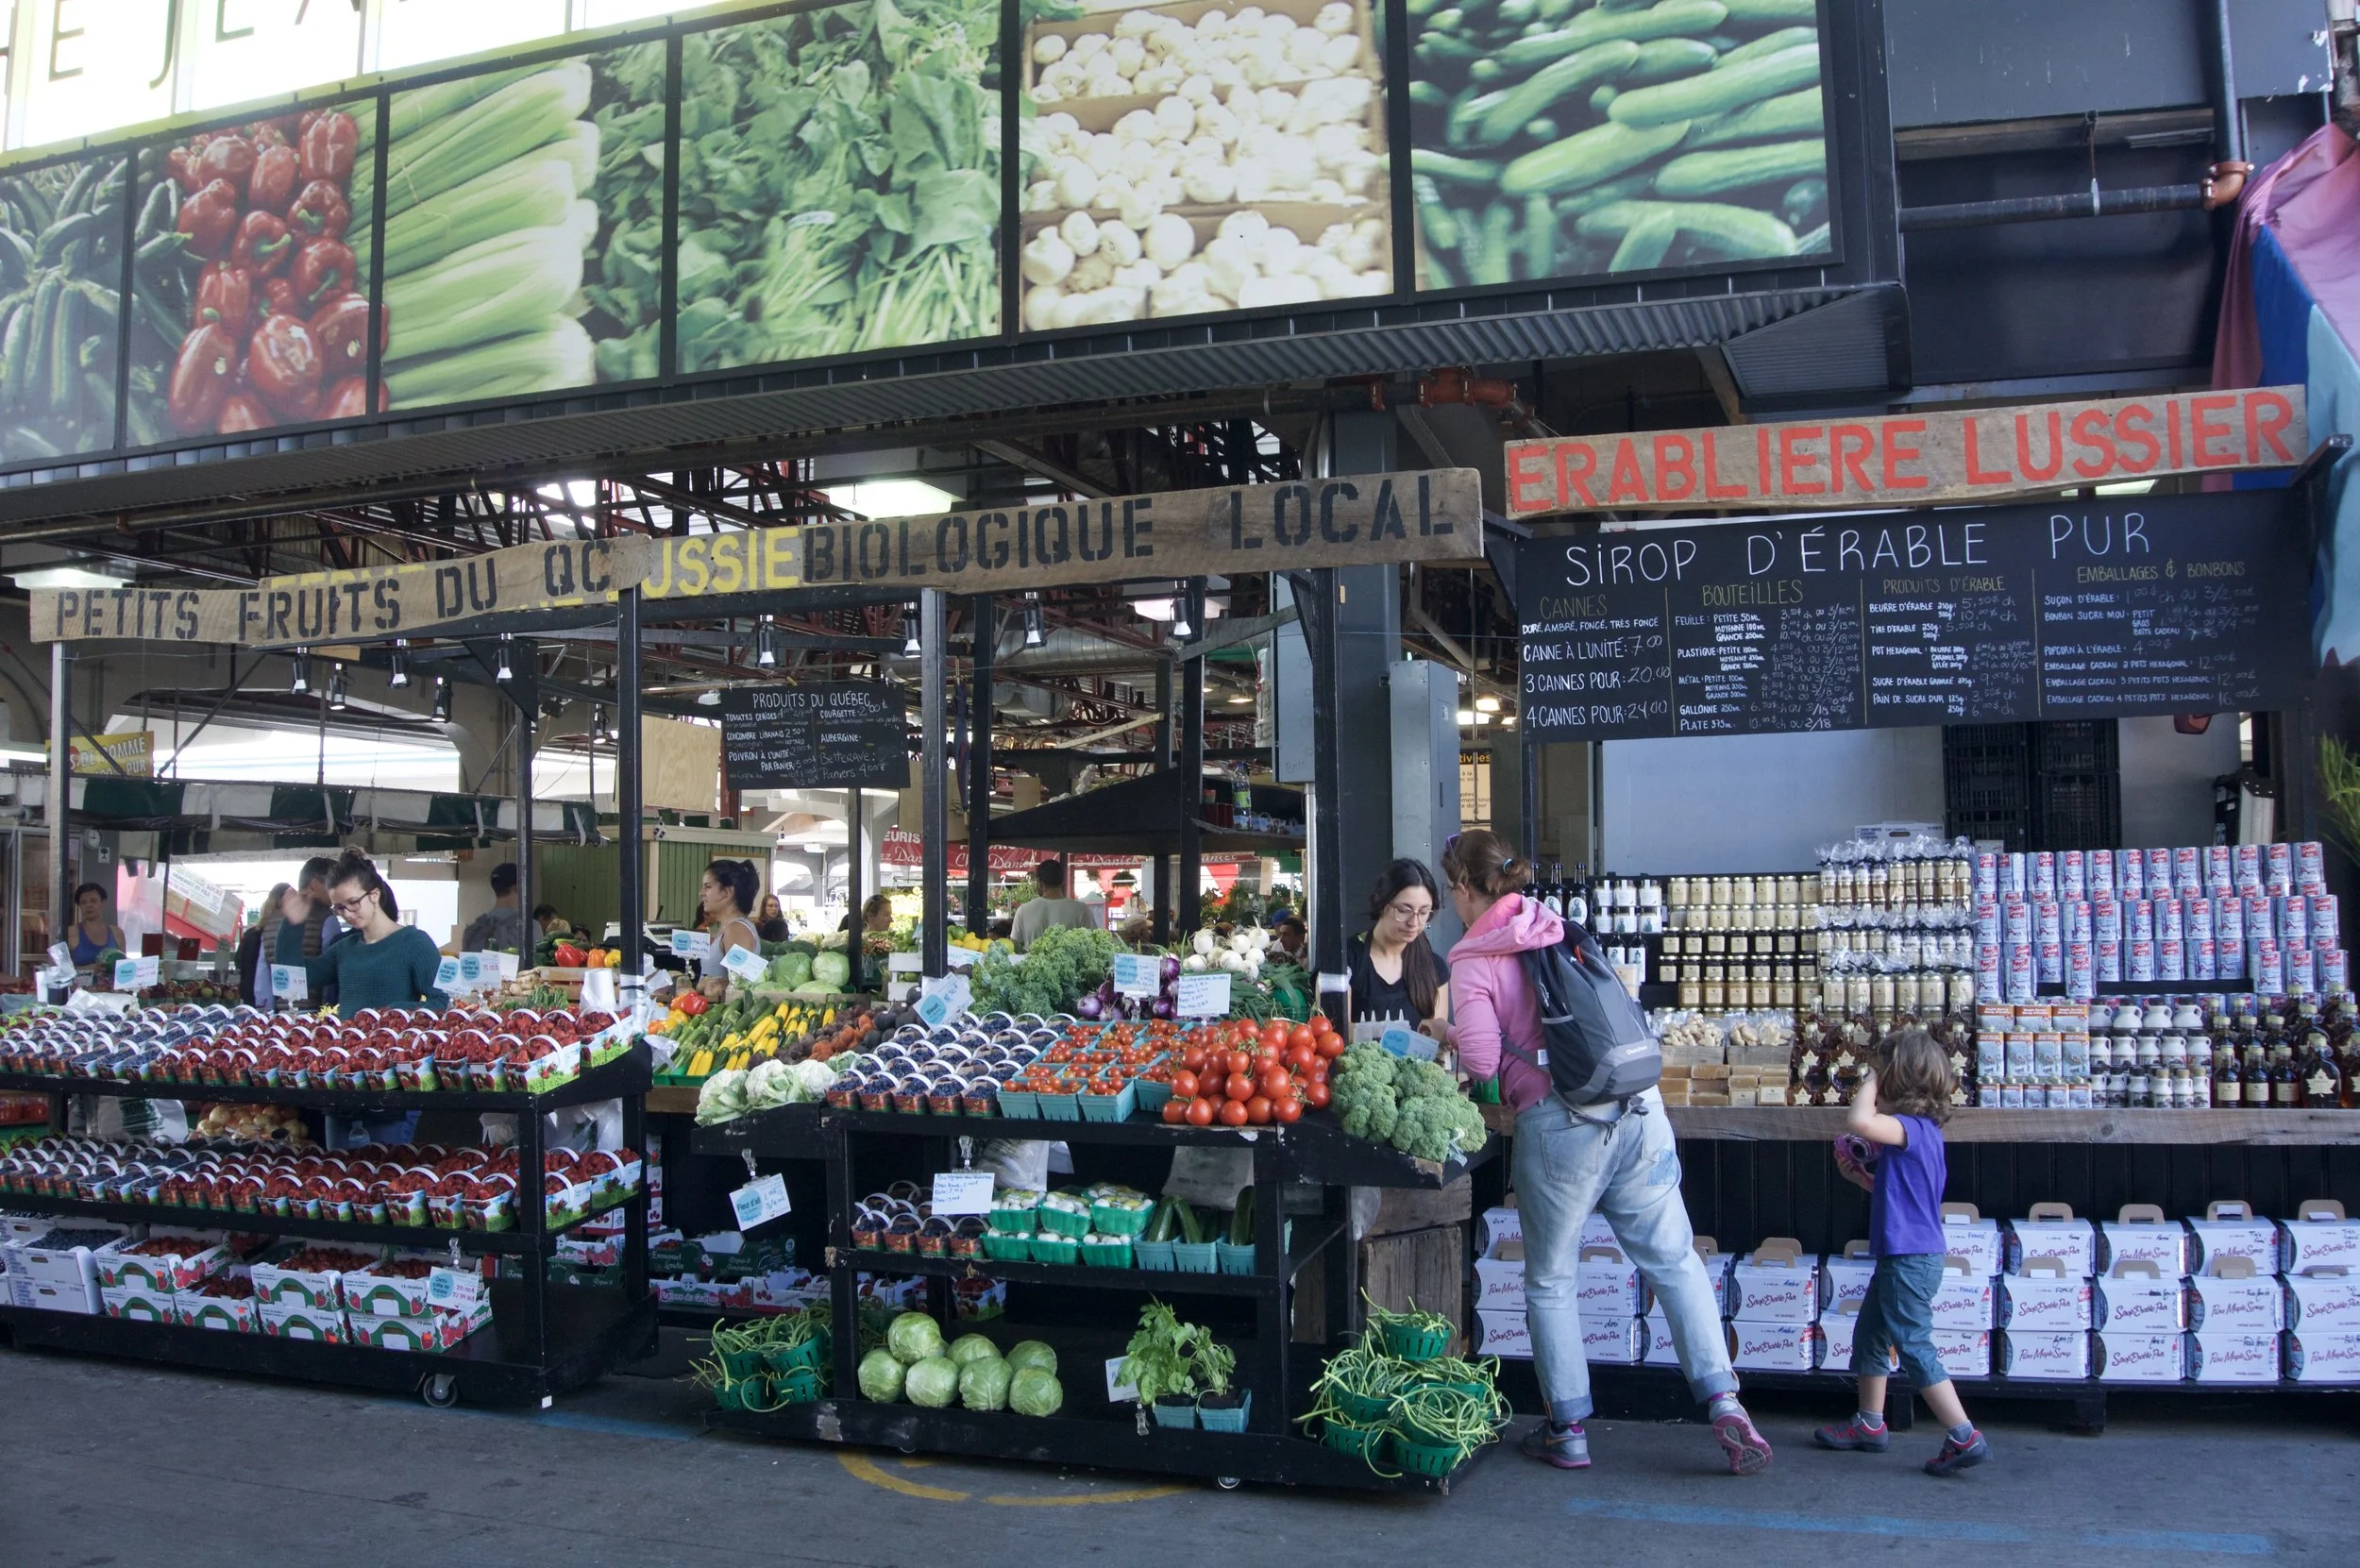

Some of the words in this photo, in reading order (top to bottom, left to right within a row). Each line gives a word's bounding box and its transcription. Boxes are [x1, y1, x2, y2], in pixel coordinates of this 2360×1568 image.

[1509, 419, 1928, 512] ERABLIERE
[1964, 393, 2295, 485] LUSSIER
[803, 497, 1154, 582] BIOLOGIQUE
[1231, 475, 1454, 550] LOCAL
[1747, 521, 1987, 578] D'ÉRABLE
[2050, 512, 2150, 560] PUR
[641, 526, 800, 599] USSIE
[2078, 565, 2158, 583] EMBALLAGES
[2187, 562, 2245, 578] BONBONS
[57, 590, 199, 640] PETITS
[239, 579, 401, 641] FRUITS
[435, 557, 497, 618] DU
[544, 541, 610, 597] QC
[1883, 579, 1940, 594] PRODUITS
[1702, 580, 1804, 606] BOUTEILLES
[1540, 594, 1608, 619] CANNES
[2045, 596, 2072, 607] SUÇON
[1869, 603, 1897, 613] BEURRE
[1713, 613, 1739, 624] PETITE
[2045, 612, 2073, 621] BONBON
[2077, 610, 2104, 620] SUCRE
[2132, 609, 2156, 618] PETIT
[1610, 618, 1630, 630] TRÈS
[1633, 616, 1659, 627] FONCÉ
[1715, 624, 1745, 632] MOYENNE
[2132, 618, 2150, 629] GROS
[1716, 632, 1744, 642] GRANDE
[2154, 627, 2180, 635] CADEAU
[1523, 644, 1562, 662] CANNE
[1566, 641, 1575, 659] À
[1719, 646, 1741, 655] PETITE
[1872, 646, 1884, 656] POT
[2045, 645, 2075, 656] POPCORN
[2078, 643, 2083, 653] À
[2044, 661, 2086, 671] EMBALLAGE
[2090, 661, 2117, 669] CADEAU
[2131, 660, 2148, 668] POTS
[1526, 674, 1536, 692] 3
[1538, 672, 1585, 692] CANNES
[1872, 677, 1894, 686] SUCRE
[2046, 677, 2087, 687] EMBALLAGE
[2087, 677, 2116, 686] CADEAU
[2128, 674, 2151, 684] PETITS
[2152, 674, 2170, 683] POTS
[752, 690, 805, 709] PRODUITS
[811, 693, 824, 707] DU
[830, 690, 870, 707] QUÉBEC
[1893, 695, 1902, 703] DE
[1905, 695, 1927, 703] SUCRE
[1929, 694, 1944, 703] DUR
[2047, 694, 2085, 704] EMBALLAGE
[2087, 694, 2115, 703] CADEAU
[2117, 694, 2123, 703] 4
[2124, 693, 2148, 702] PETITS
[2149, 693, 2166, 702] POTS
[1680, 704, 1717, 715] GALLONNE
[725, 713, 753, 721] TOMATES
[1526, 706, 1537, 728] 4
[1539, 705, 1586, 727] CANNES
[1680, 718, 1708, 731] PLATE
[729, 750, 758, 761] POIVRON
[761, 750, 766, 759] À
[1459, 754, 1491, 763] tives
[126, 759, 146, 774] PUR
[761, 761, 773, 771] PAR
